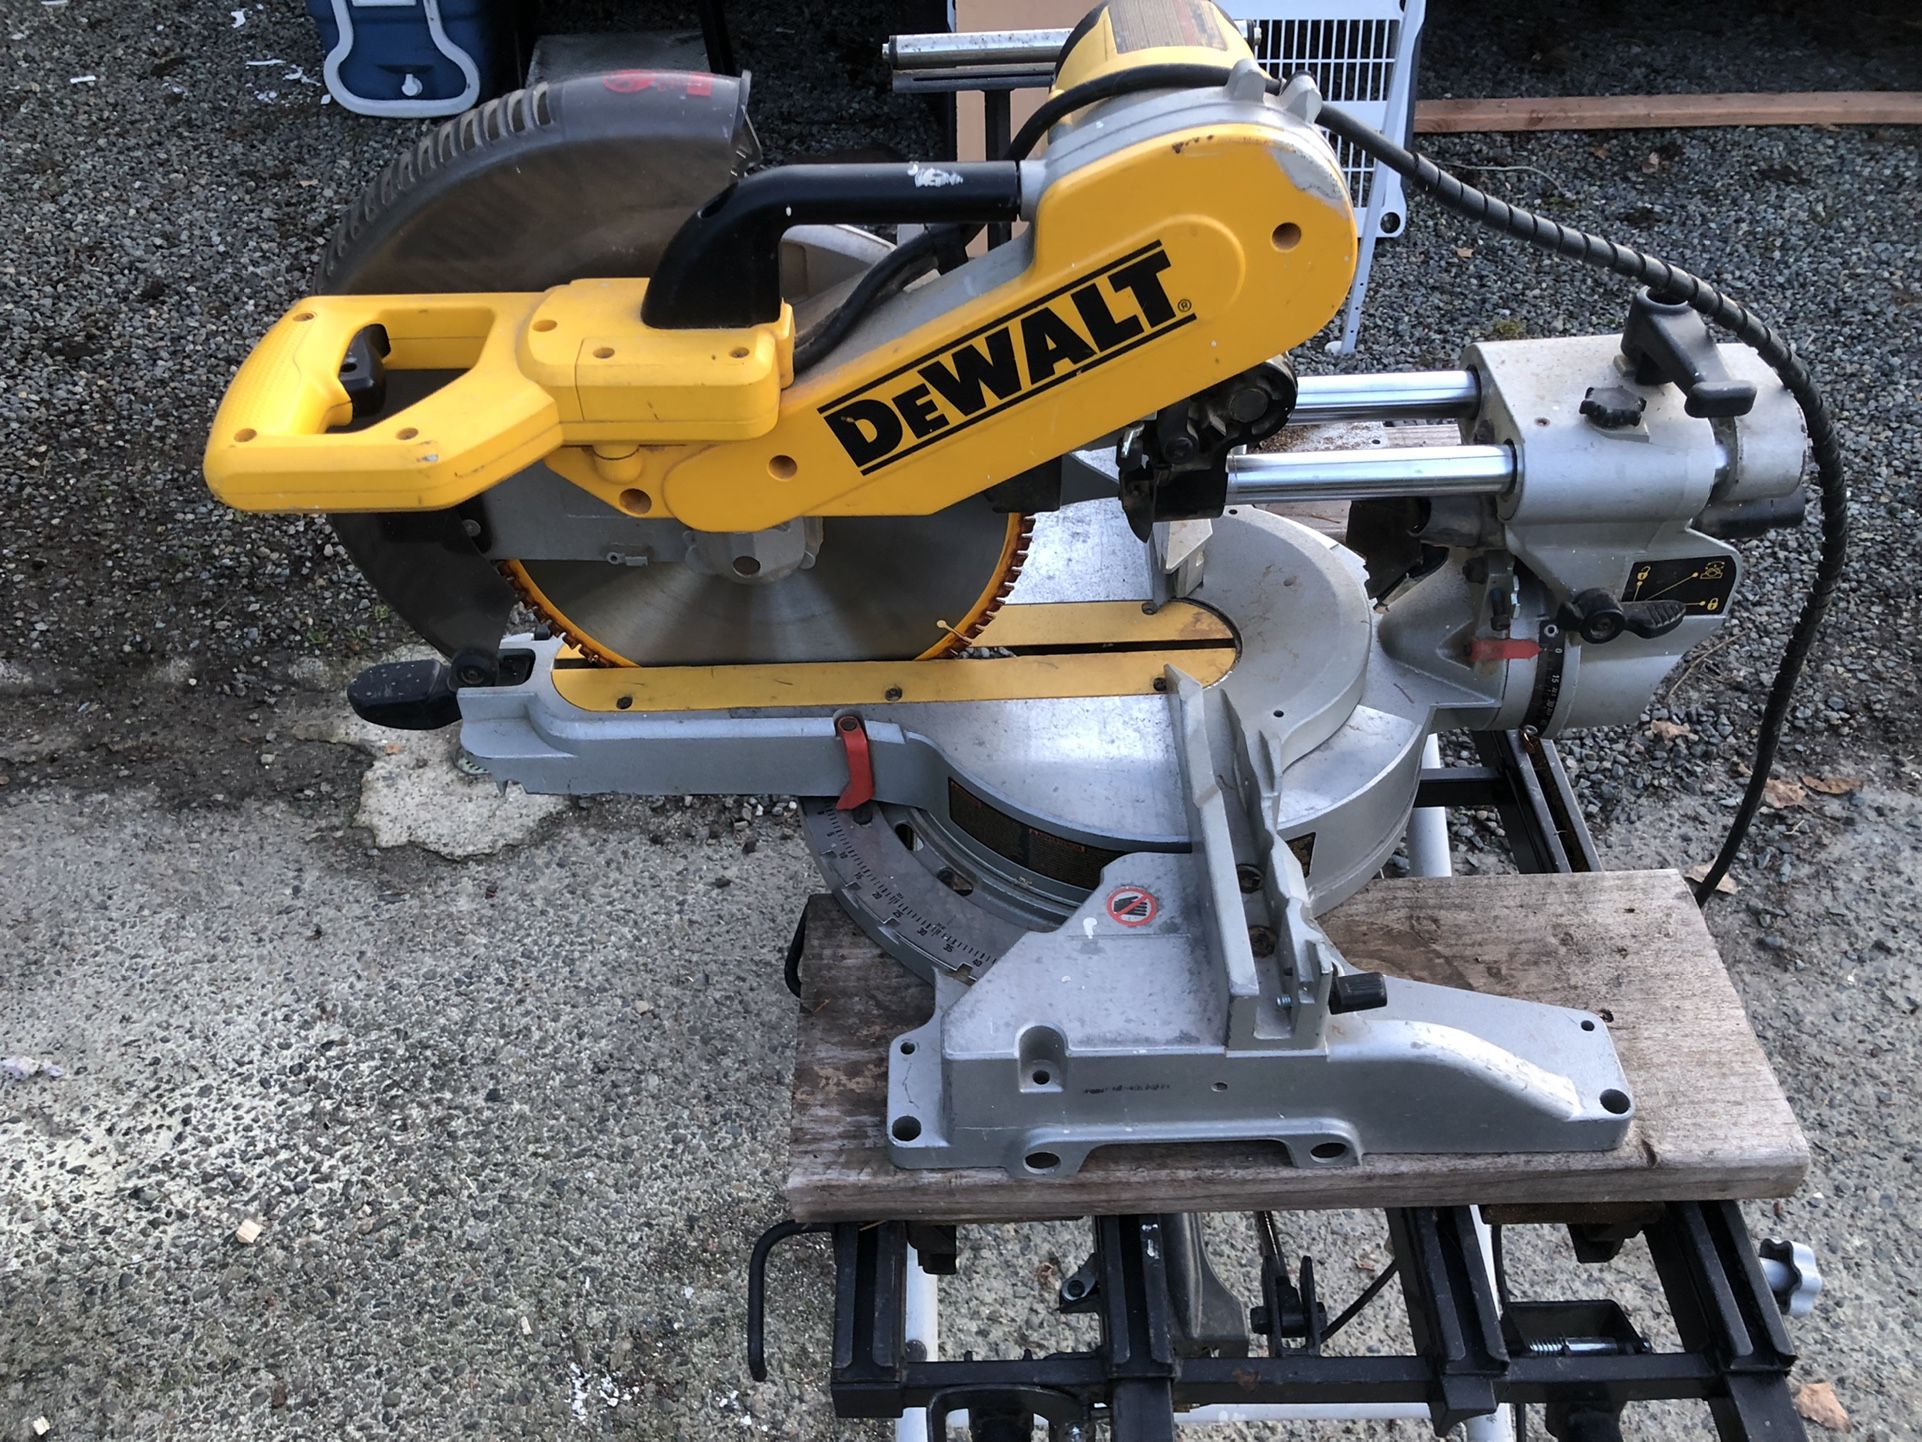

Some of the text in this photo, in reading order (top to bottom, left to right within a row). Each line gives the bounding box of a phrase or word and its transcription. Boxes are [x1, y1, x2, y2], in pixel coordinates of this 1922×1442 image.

[824, 249, 1177, 468] DEWALT
[1551, 674, 1560, 684] 15
[872, 892, 883, 900] 20
[893, 910, 904, 918] 25
[916, 927, 928, 936] 30
[943, 944, 955, 952] 35
[973, 959, 983, 968] 40
